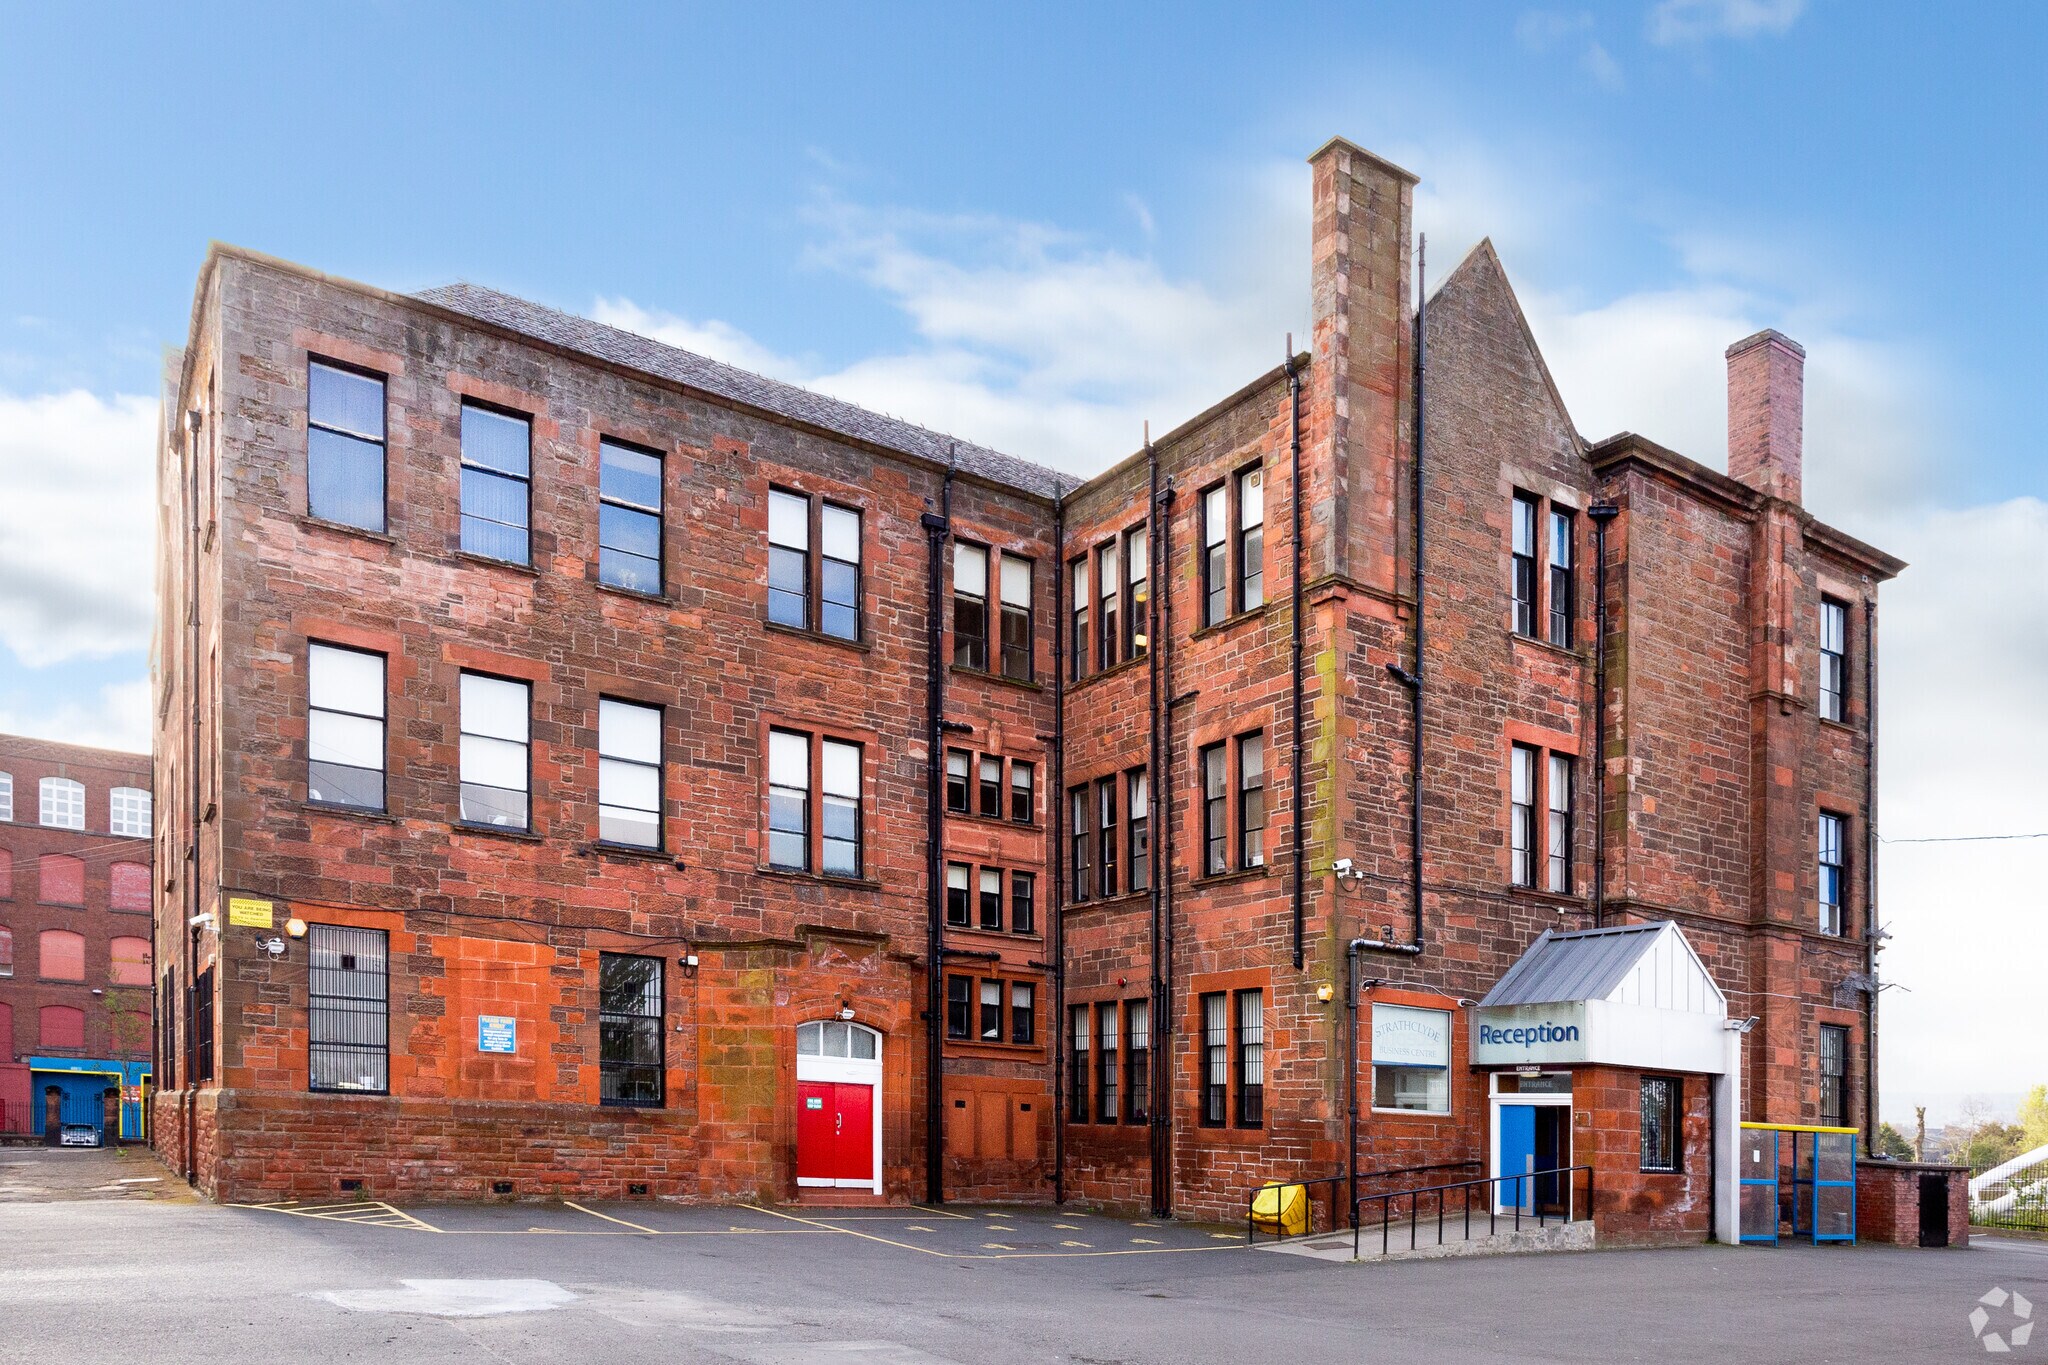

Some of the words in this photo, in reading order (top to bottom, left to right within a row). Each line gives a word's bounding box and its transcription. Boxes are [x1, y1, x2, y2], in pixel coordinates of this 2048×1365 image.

[1375, 1020, 1441, 1042] STRATHCLYDE
[1480, 1021, 1579, 1048] Reception
[1380, 1046, 1410, 1056] BUSINESS
[1410, 1048, 1437, 1058] CENTRE
[1520, 1080, 1553, 1088] ENTRANCE
